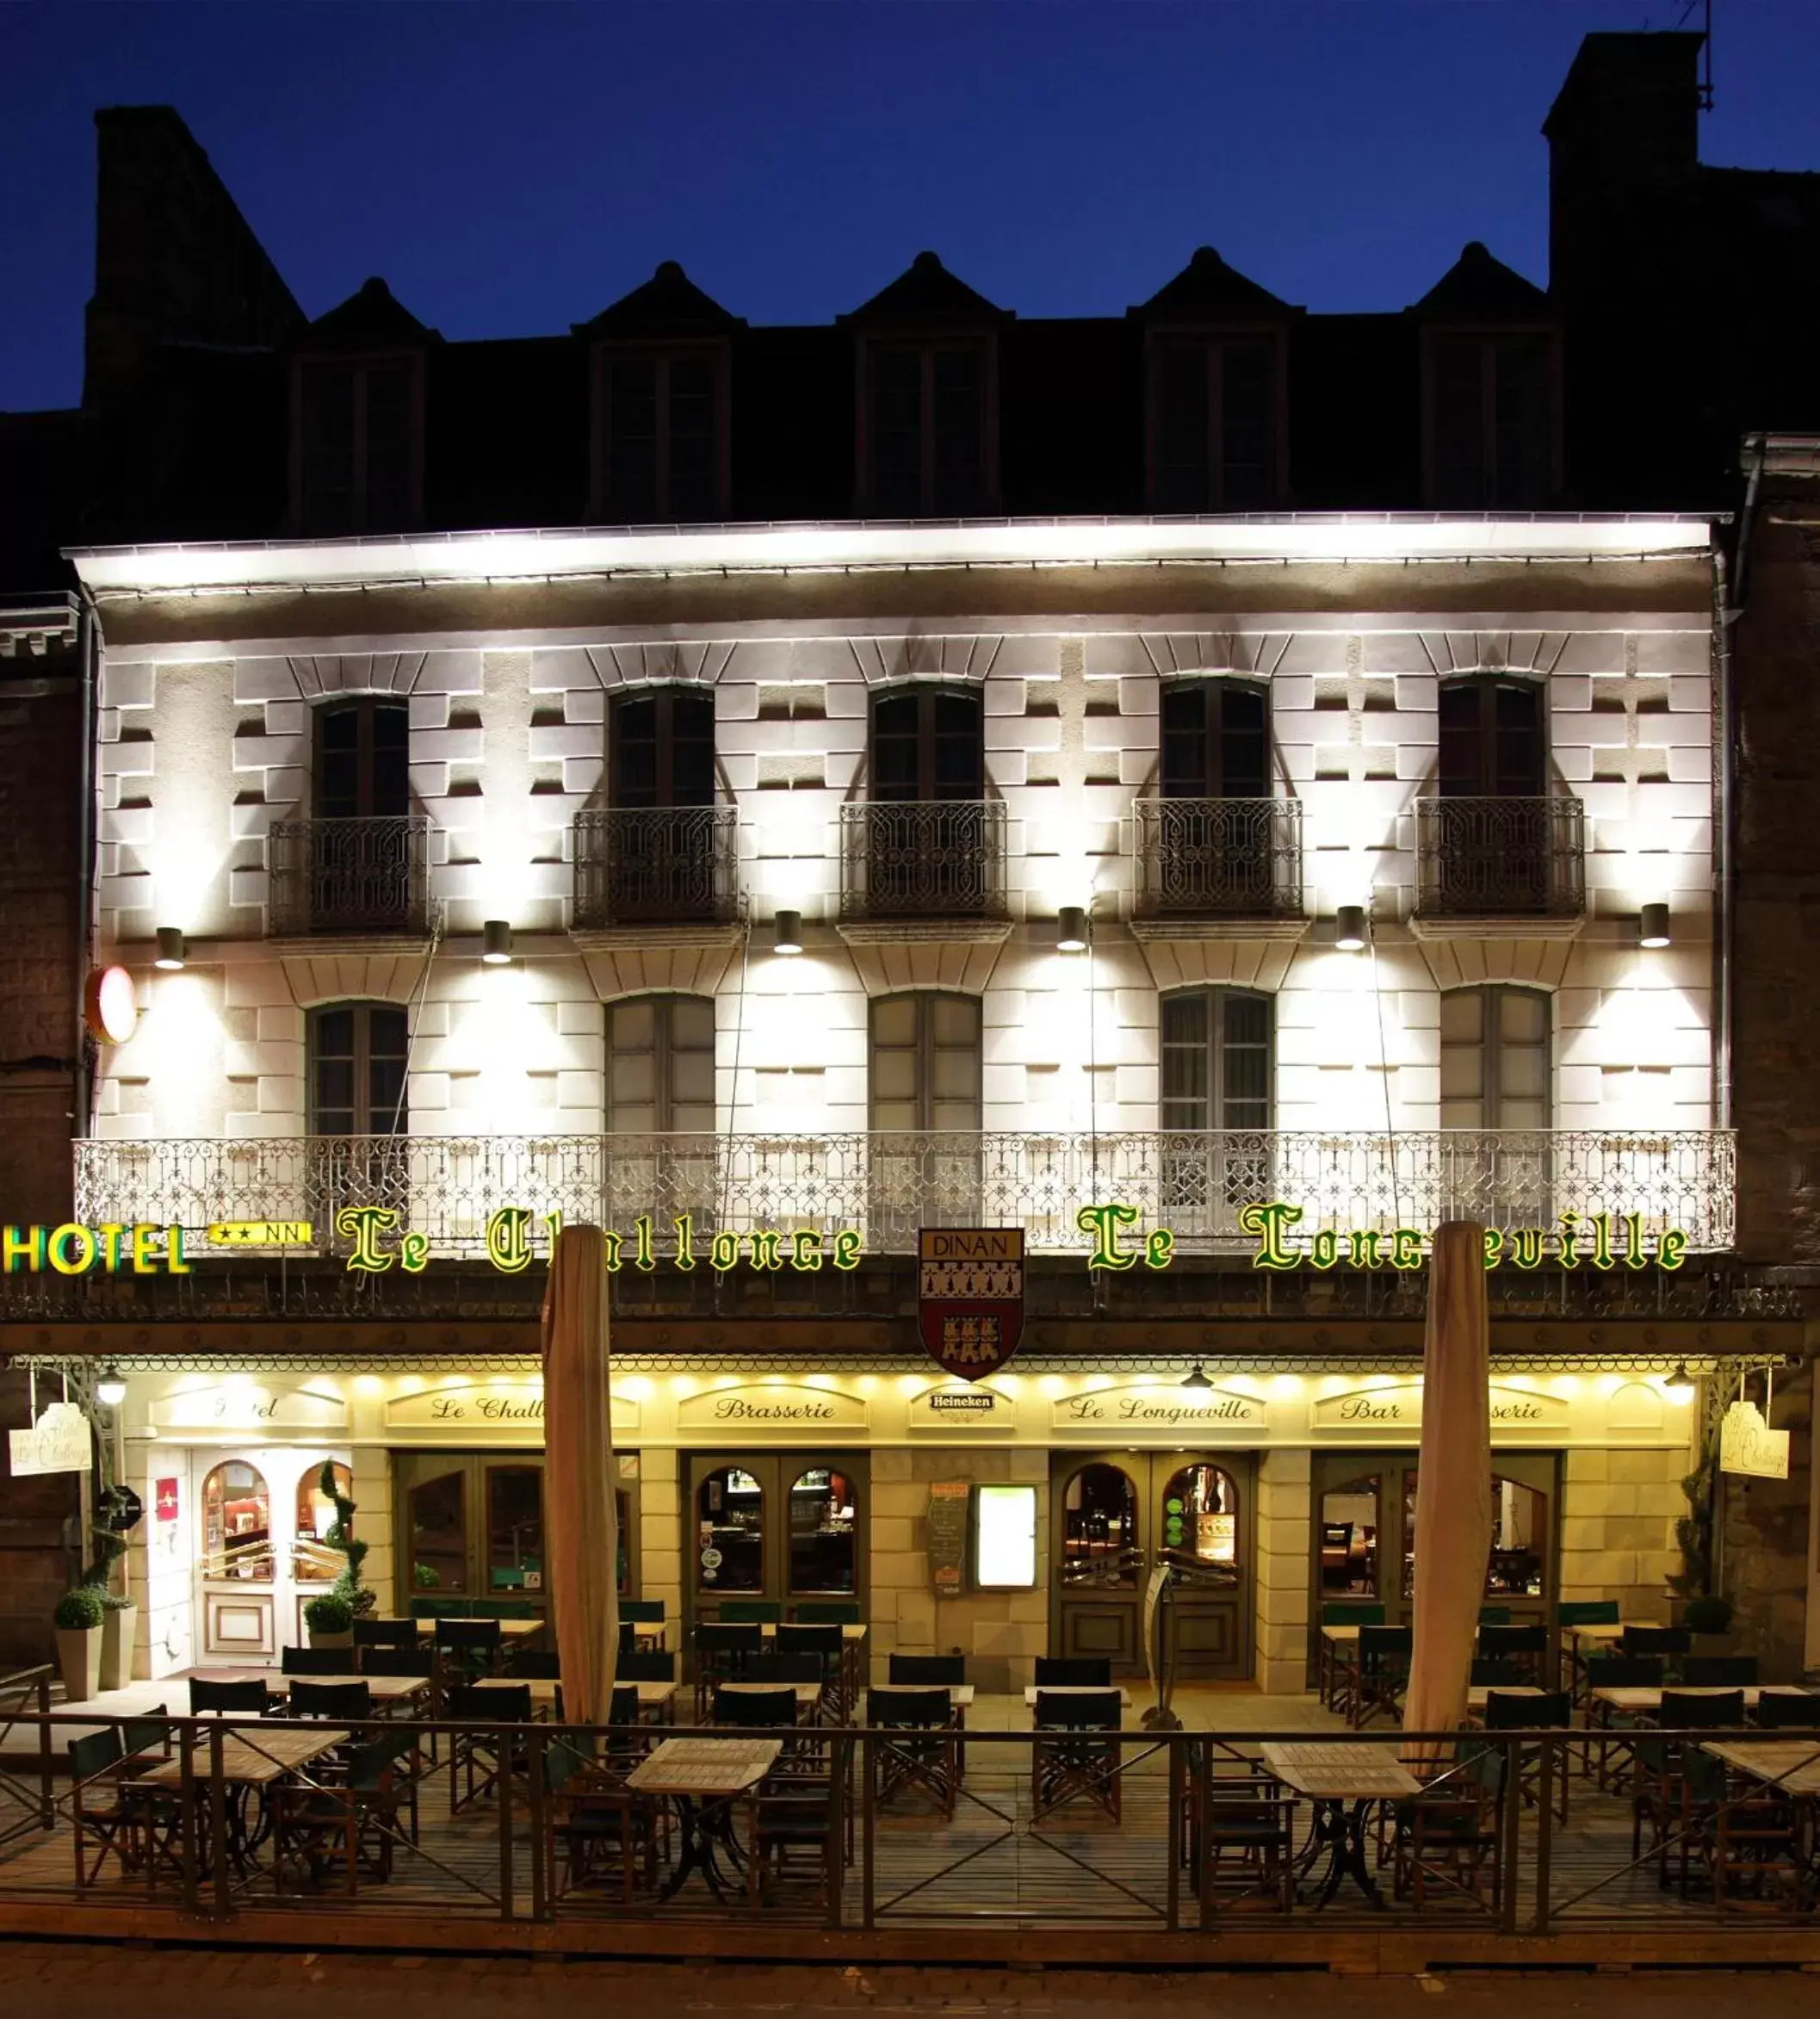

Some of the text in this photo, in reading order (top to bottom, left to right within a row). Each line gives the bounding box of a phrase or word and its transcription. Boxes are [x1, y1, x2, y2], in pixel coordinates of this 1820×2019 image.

[265, 1224, 300, 1241] NN
[336, 1206, 430, 1273] Le
[1076, 1204, 1690, 1271] Le Longeville
[3, 1223, 193, 1275] HOTEL
[933, 1236, 1008, 1256] DINAN
[431, 1398, 466, 1419] Le
[715, 1397, 835, 1419] Brasserie
[933, 1396, 991, 1408] Heineken
[1069, 1398, 1252, 1424] Le Longueville
[1340, 1397, 1402, 1419] Bar
